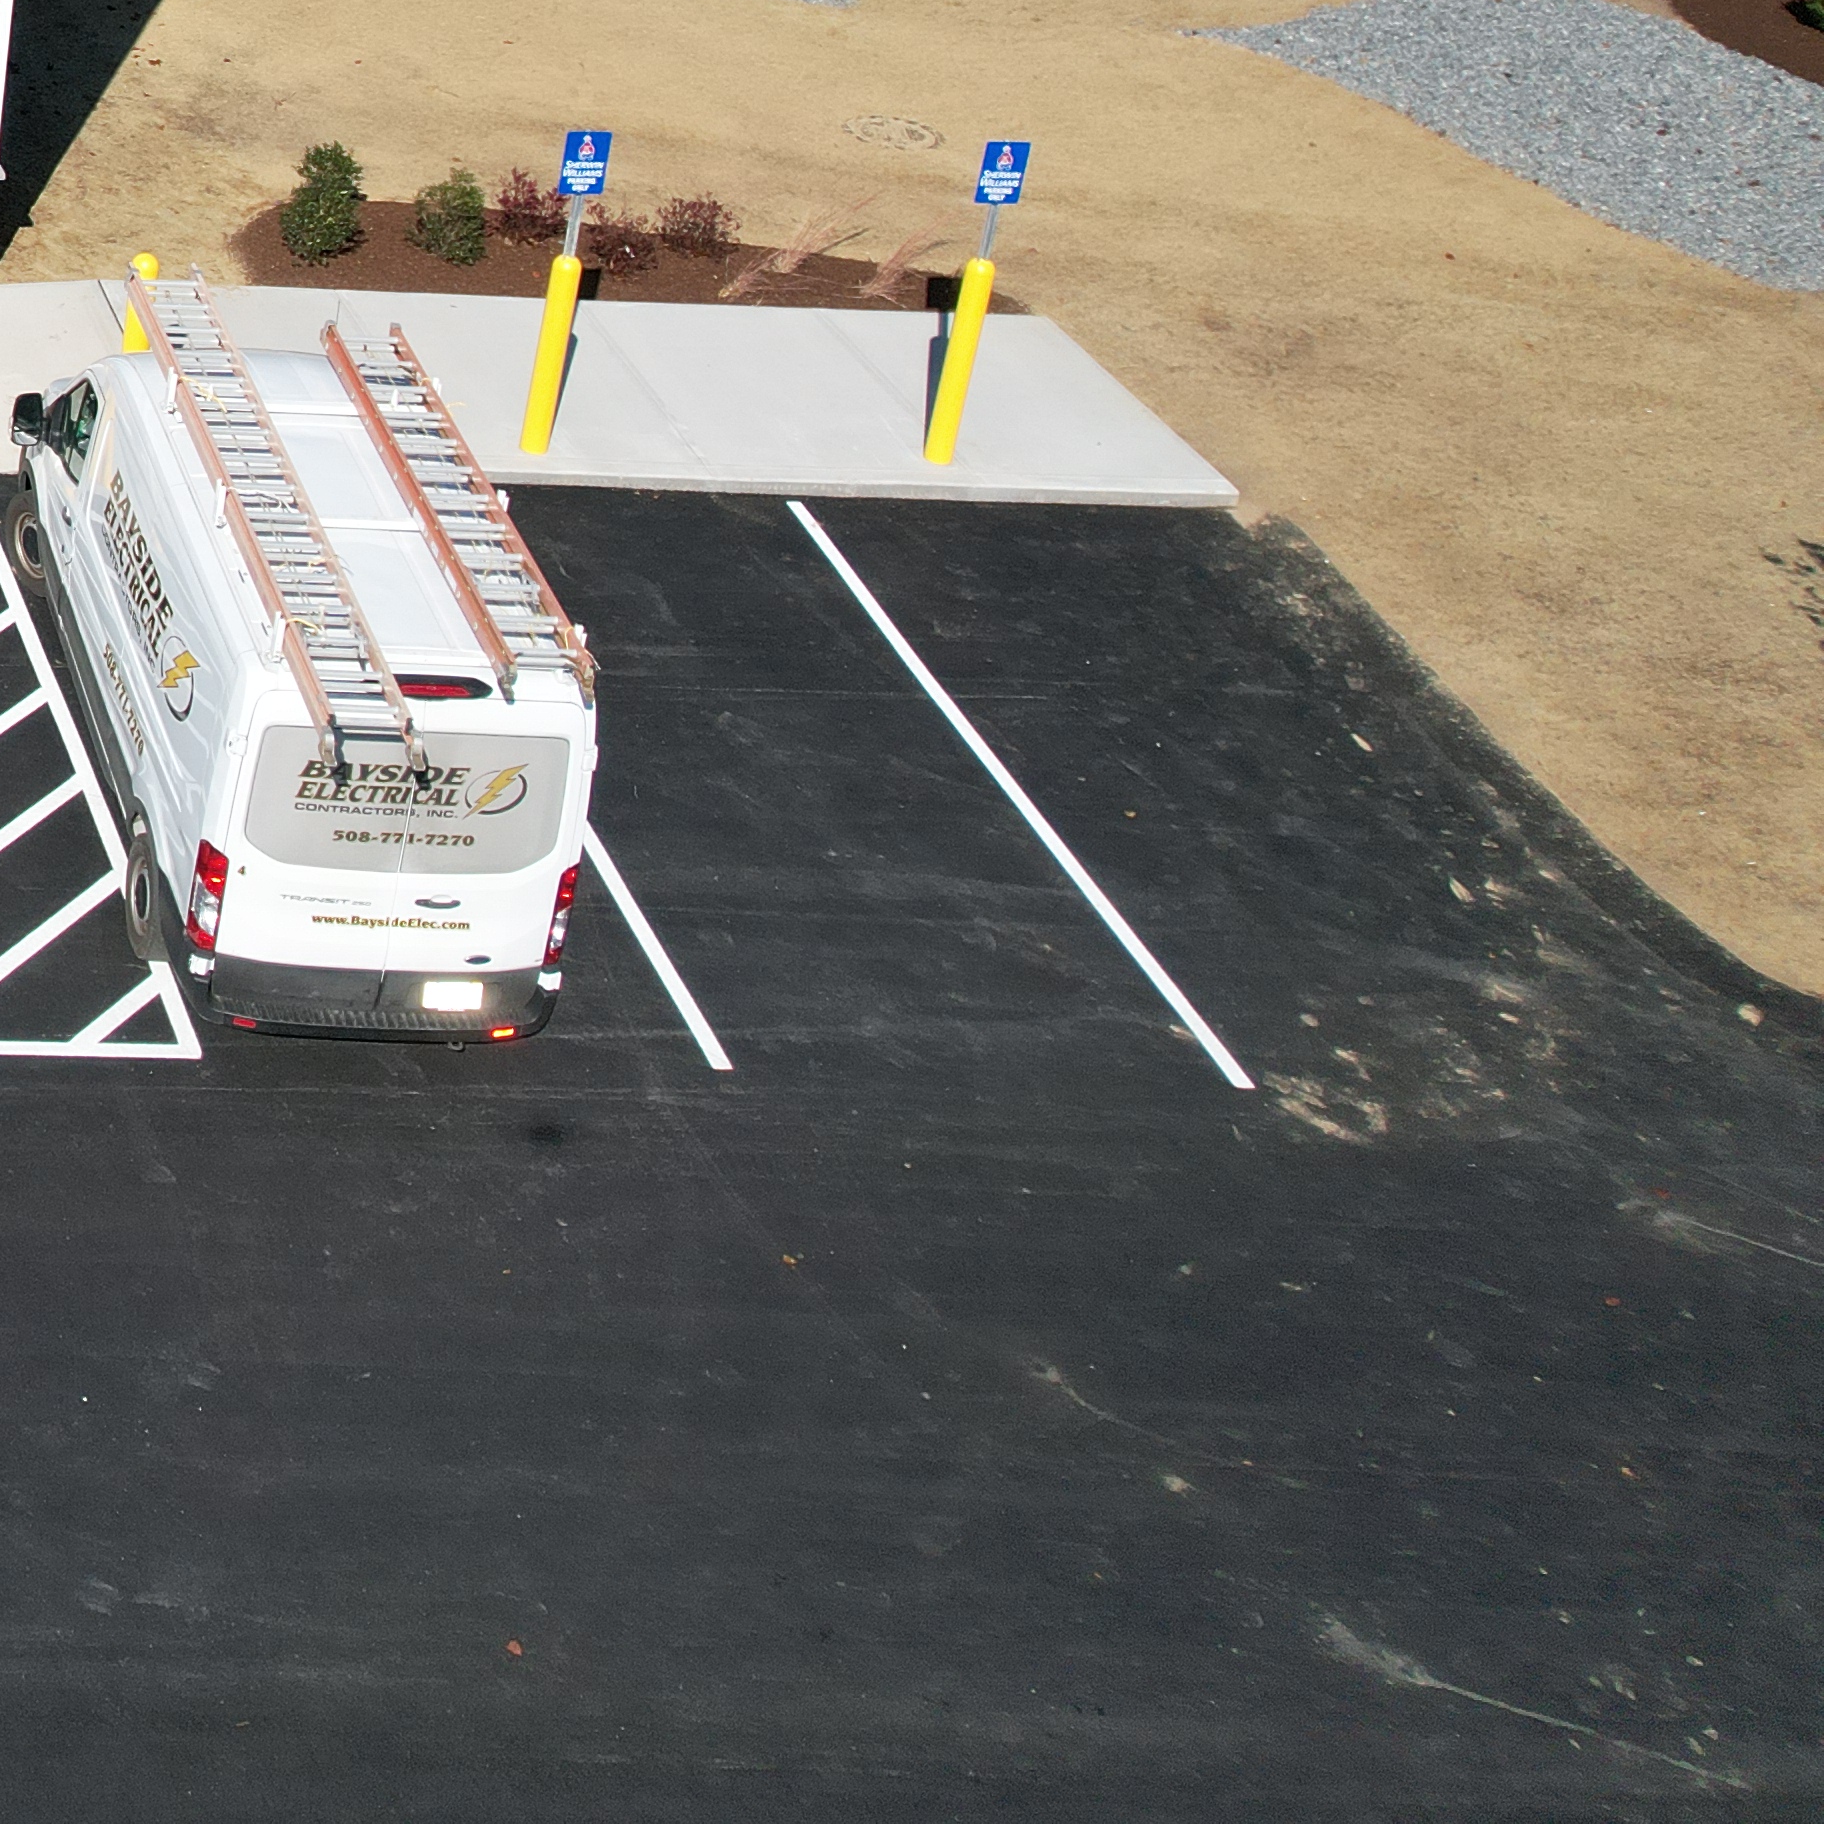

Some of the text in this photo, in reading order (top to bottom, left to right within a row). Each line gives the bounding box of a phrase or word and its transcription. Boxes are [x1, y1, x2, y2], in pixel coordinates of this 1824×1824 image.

[109, 467, 174, 631] BAYSIDE
[103, 497, 162, 659] ELECTRICAL
[102, 643, 145, 757] 508-771-7270
[297, 759, 472, 786] BAYSIDE
[295, 780, 461, 807] ELECTRICAL
[426, 808, 459, 820] INC.
[331, 829, 476, 848] 508-771-7270
[237, 865, 246, 876] 4
[279, 893, 351, 906] TRANSIT
[311, 914, 471, 931] www.BaysideElec.com
